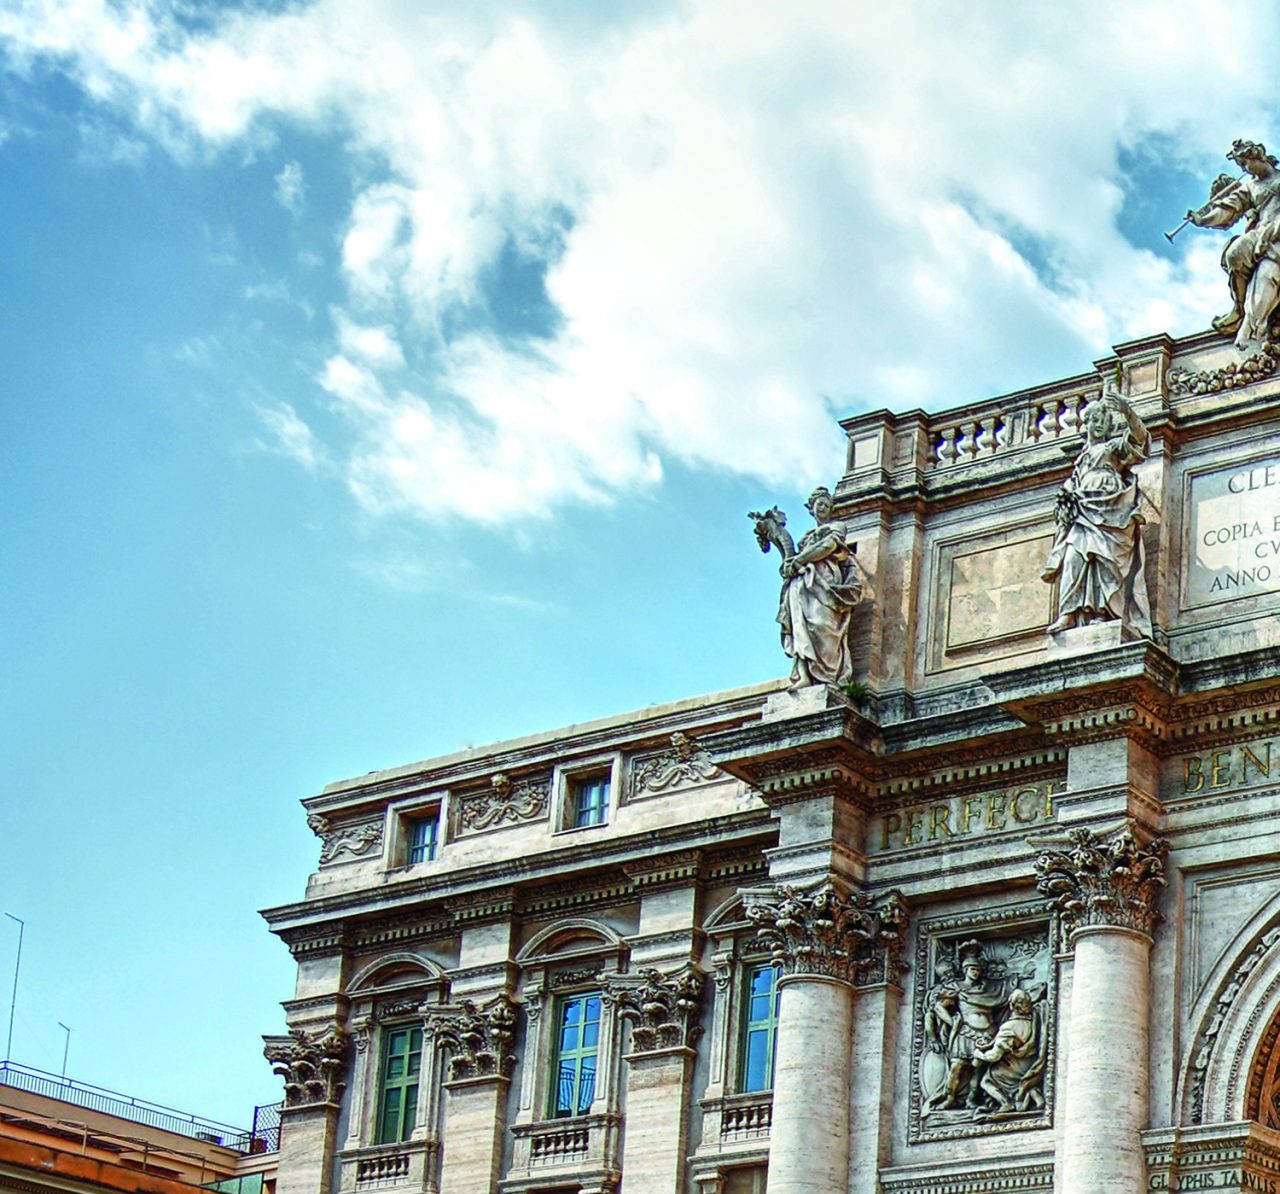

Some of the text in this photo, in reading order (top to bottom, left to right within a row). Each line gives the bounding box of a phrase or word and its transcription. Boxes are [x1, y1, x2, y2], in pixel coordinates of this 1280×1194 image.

[1203, 521, 1262, 547] COPIA
[1210, 565, 1271, 592] ANNO
[880, 780, 1067, 850] PERFECI
